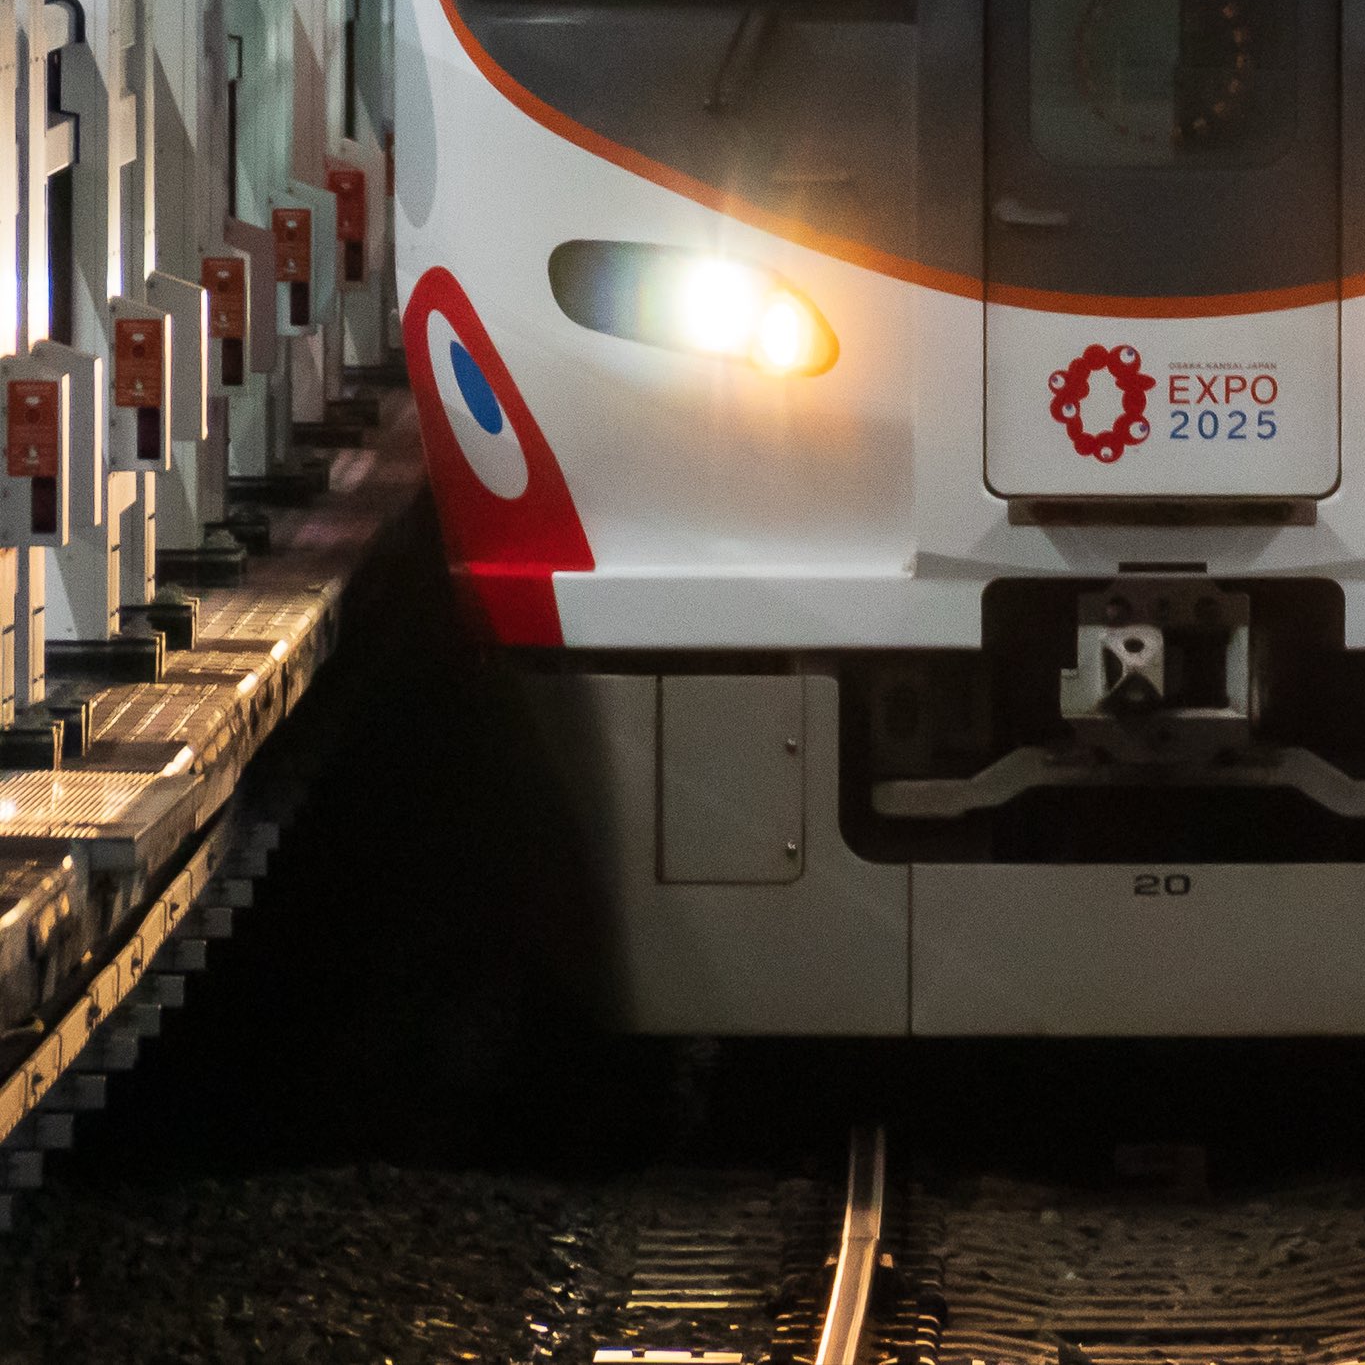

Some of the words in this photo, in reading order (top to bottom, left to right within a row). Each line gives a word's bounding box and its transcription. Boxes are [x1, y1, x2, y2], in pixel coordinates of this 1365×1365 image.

[1168, 374, 1279, 405] EXPO
[1169, 409, 1278, 440] 2025
[1134, 874, 1191, 896] 20
